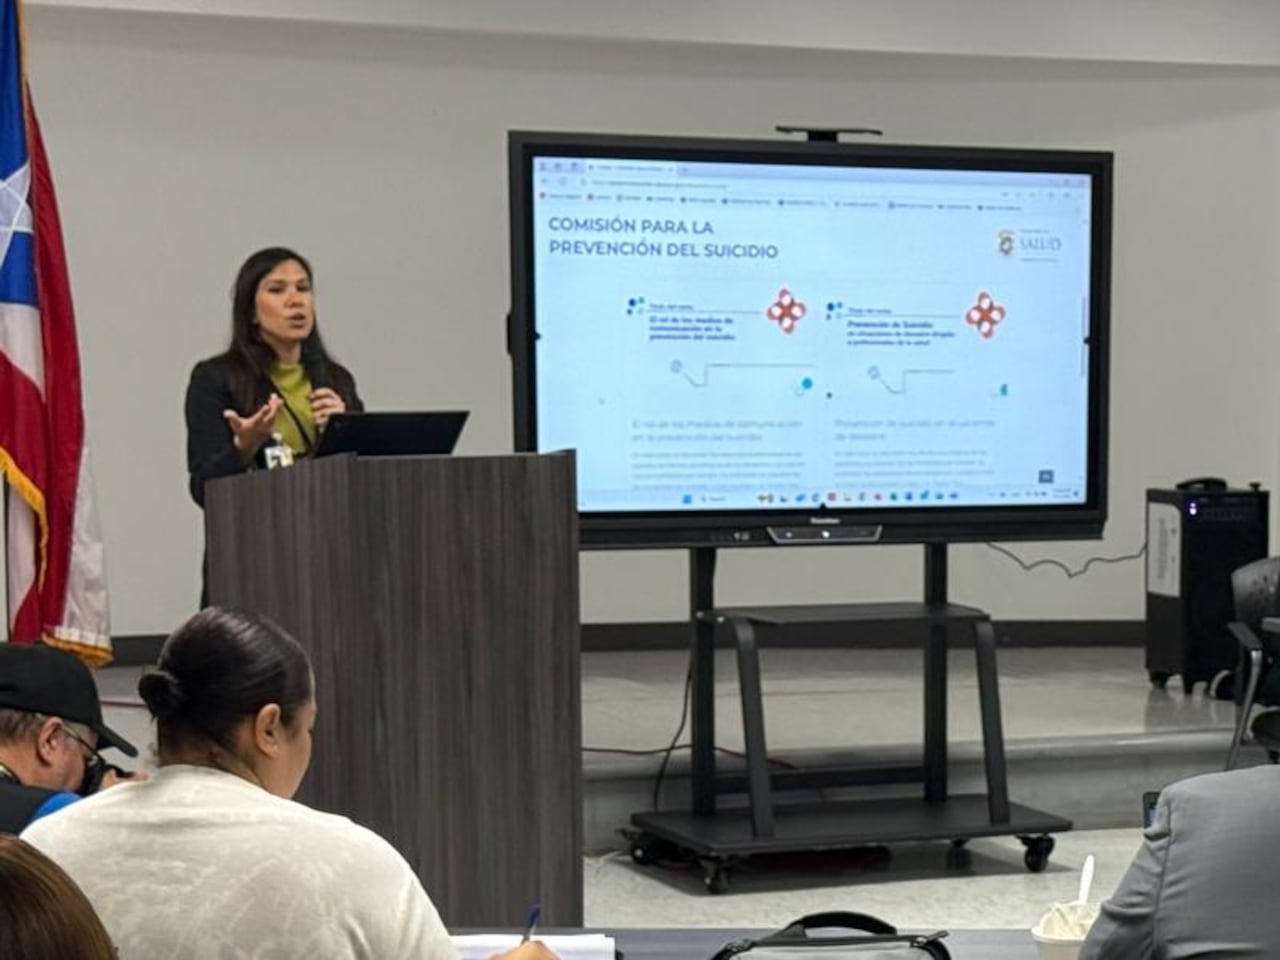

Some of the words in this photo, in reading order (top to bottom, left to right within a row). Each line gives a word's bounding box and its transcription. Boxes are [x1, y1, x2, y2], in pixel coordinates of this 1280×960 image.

[548, 214, 636, 233] COMISIÓN
[641, 219, 688, 234] PARA
[692, 220, 714, 235] LA
[549, 237, 662, 256] PREVENCIÓN
[666, 242, 700, 257] DEL
[704, 243, 779, 259] SUICIDIO
